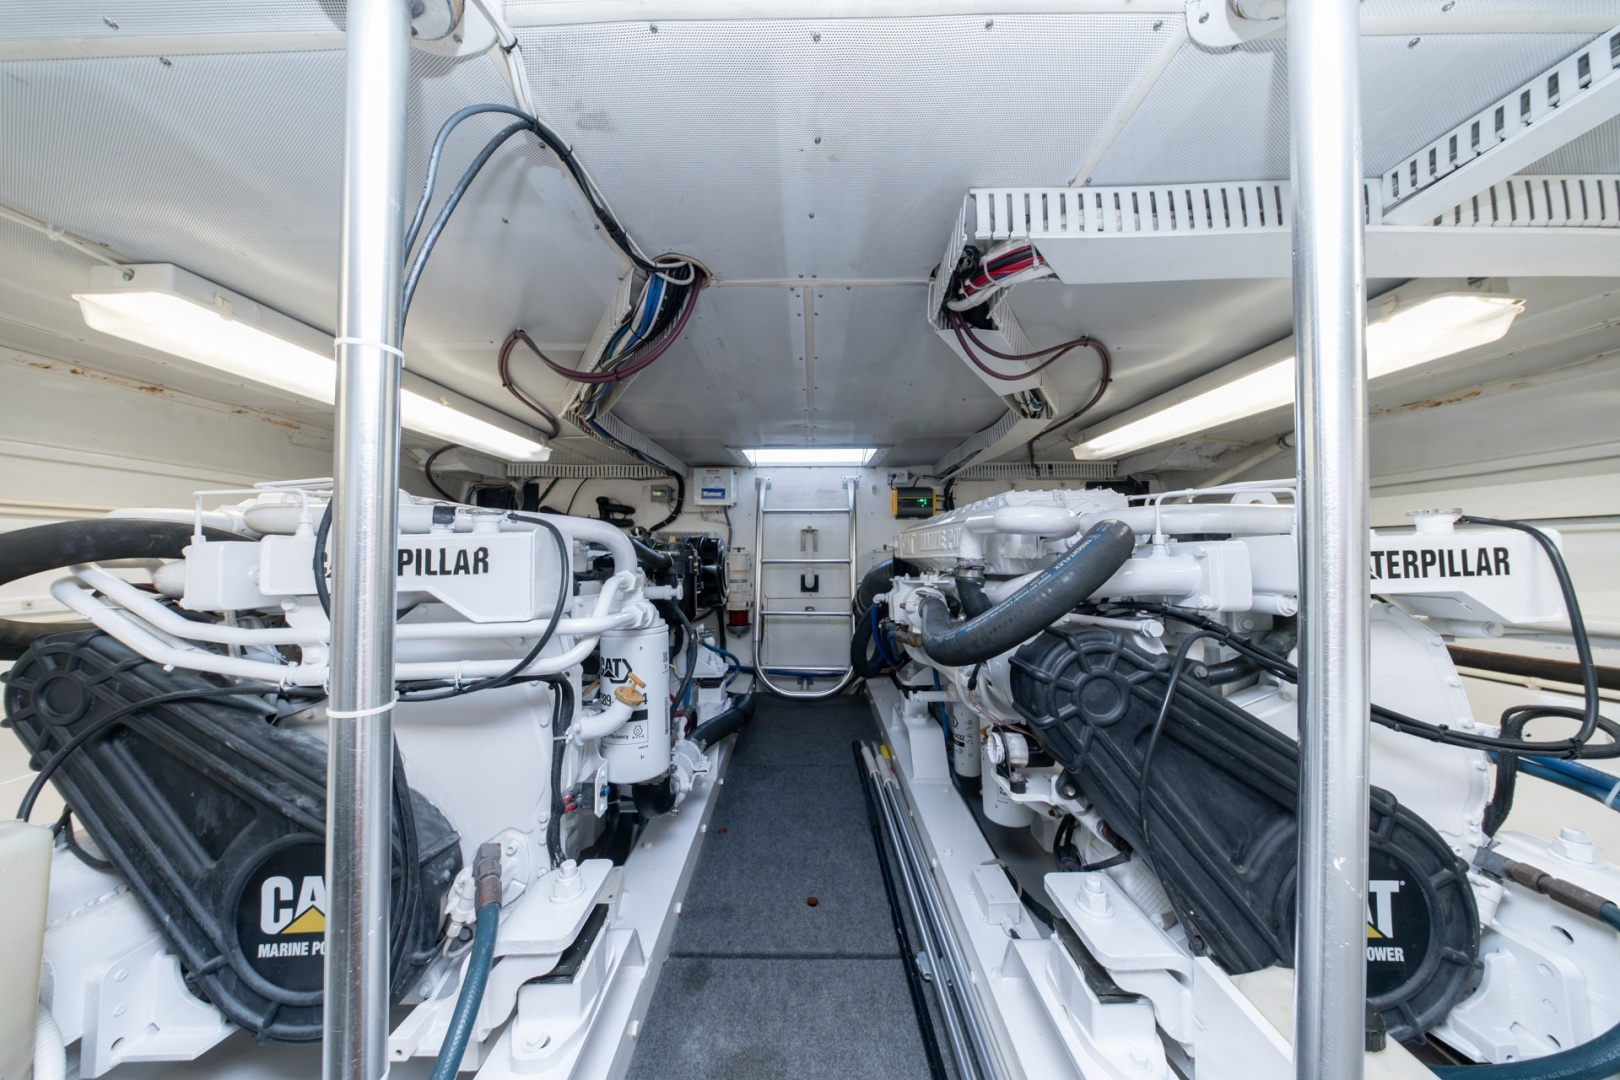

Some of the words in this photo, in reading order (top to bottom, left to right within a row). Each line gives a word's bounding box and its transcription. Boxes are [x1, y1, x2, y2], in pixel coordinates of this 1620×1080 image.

[1370, 547, 1511, 580] TERPILLAR
[261, 875, 326, 935] CA
[257, 941, 309, 959] MARINE
[1366, 946, 1405, 962] OWER
